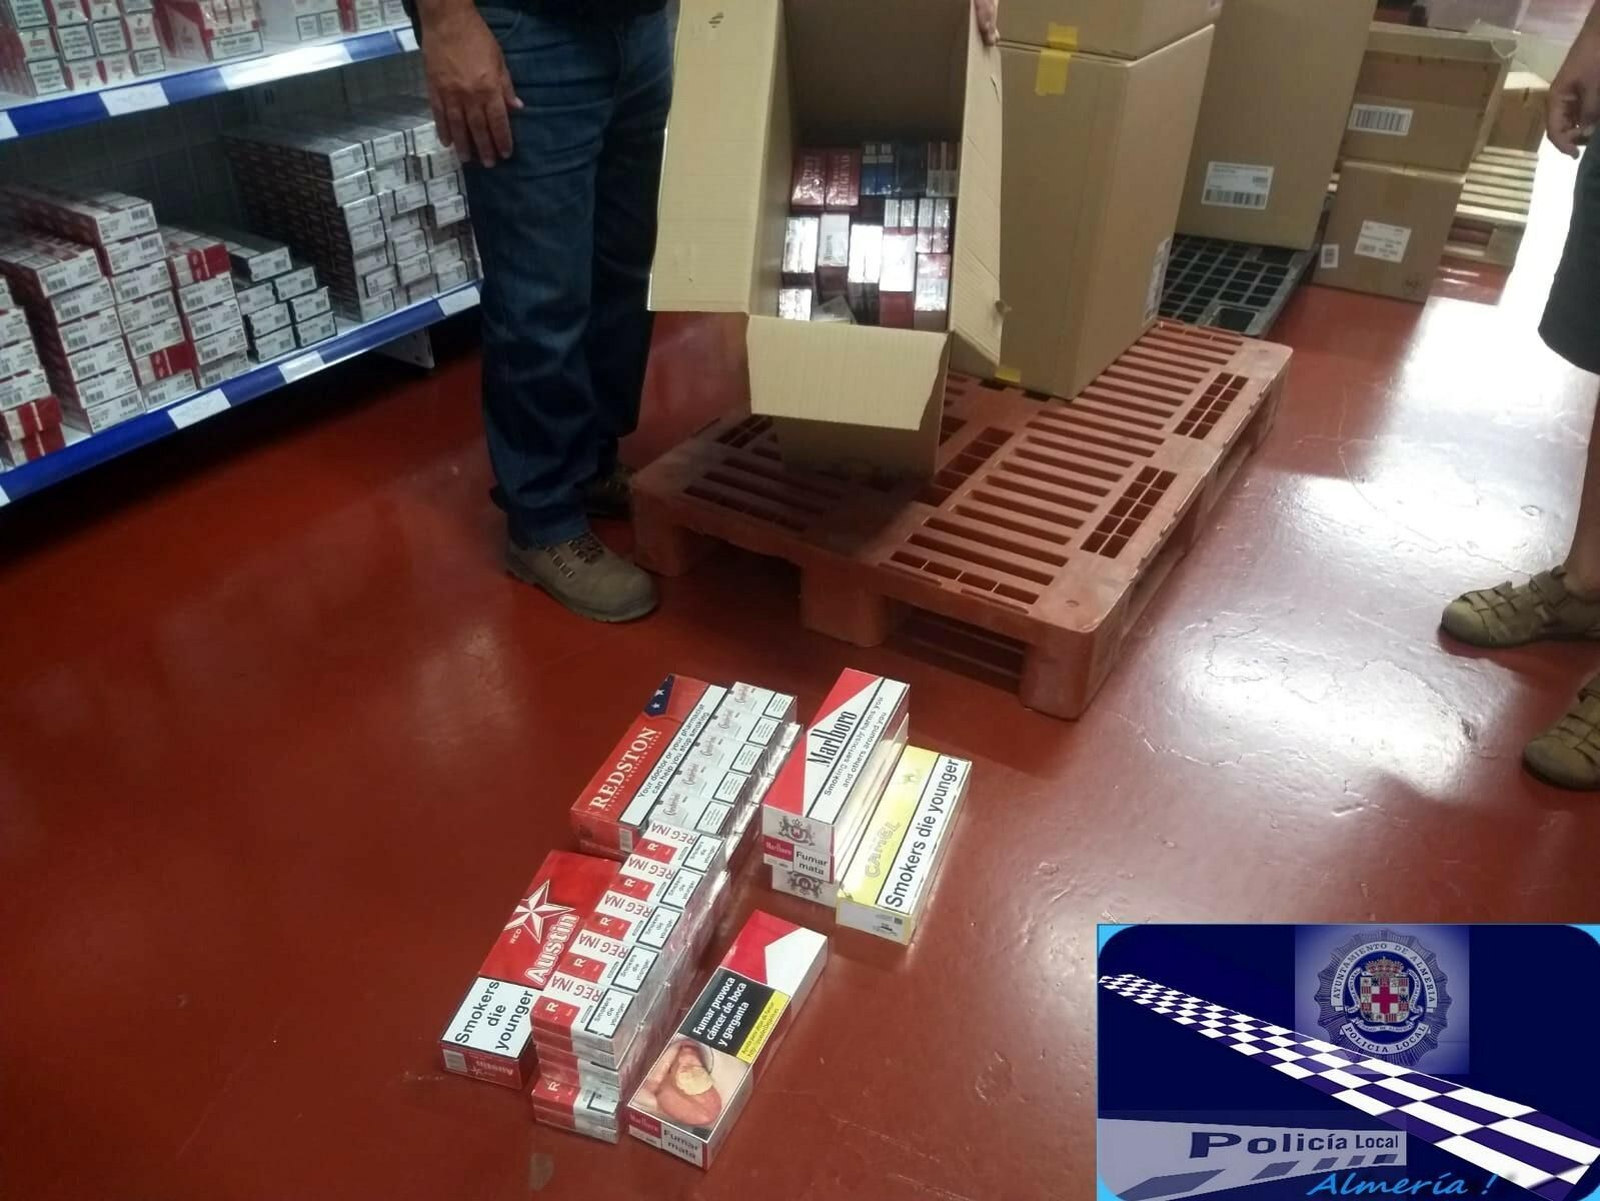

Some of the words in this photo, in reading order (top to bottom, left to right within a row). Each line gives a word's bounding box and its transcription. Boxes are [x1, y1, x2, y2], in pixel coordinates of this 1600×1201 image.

[590, 727, 658, 810] REDSTON
[638, 783, 653, 799] Your
[652, 757, 669, 783] doctor
[666, 750, 674, 761] or
[673, 735, 684, 751] your
[681, 703, 706, 736] pharmacist
[652, 781, 662, 794] can
[661, 763, 674, 781] help
[673, 752, 683, 766] you
[680, 737, 692, 753] stop
[689, 712, 711, 738] smoking
[806, 711, 857, 767] Marlboro
[824, 765, 845, 797] Smoking
[844, 731, 864, 764] seriously
[860, 707, 876, 732] harms
[873, 696, 884, 711] you
[843, 775, 852, 788] and
[850, 750, 867, 775] others
[863, 724, 879, 750] around
[876, 712, 887, 728] you
[796, 850, 829, 867] Fumar
[885, 841, 926, 909] Smokers
[916, 814, 936, 839] die
[928, 759, 959, 815] younger
[799, 862, 825, 876] mata
[524, 914, 580, 985] Austin
[455, 981, 500, 1043] Smokers
[487, 1004, 506, 1027] die
[495, 990, 534, 1050] younger
[693, 1005, 714, 1035] Fumar
[713, 976, 736, 1011] provoca
[707, 1011, 726, 1040] cáncer
[723, 1000, 735, 1015] de
[731, 982, 748, 1003] boca
[718, 1034, 729, 1047] y
[725, 1001, 750, 1040] garganta
[664, 1128, 699, 1151] Fumar
[667, 1141, 697, 1160] mata
